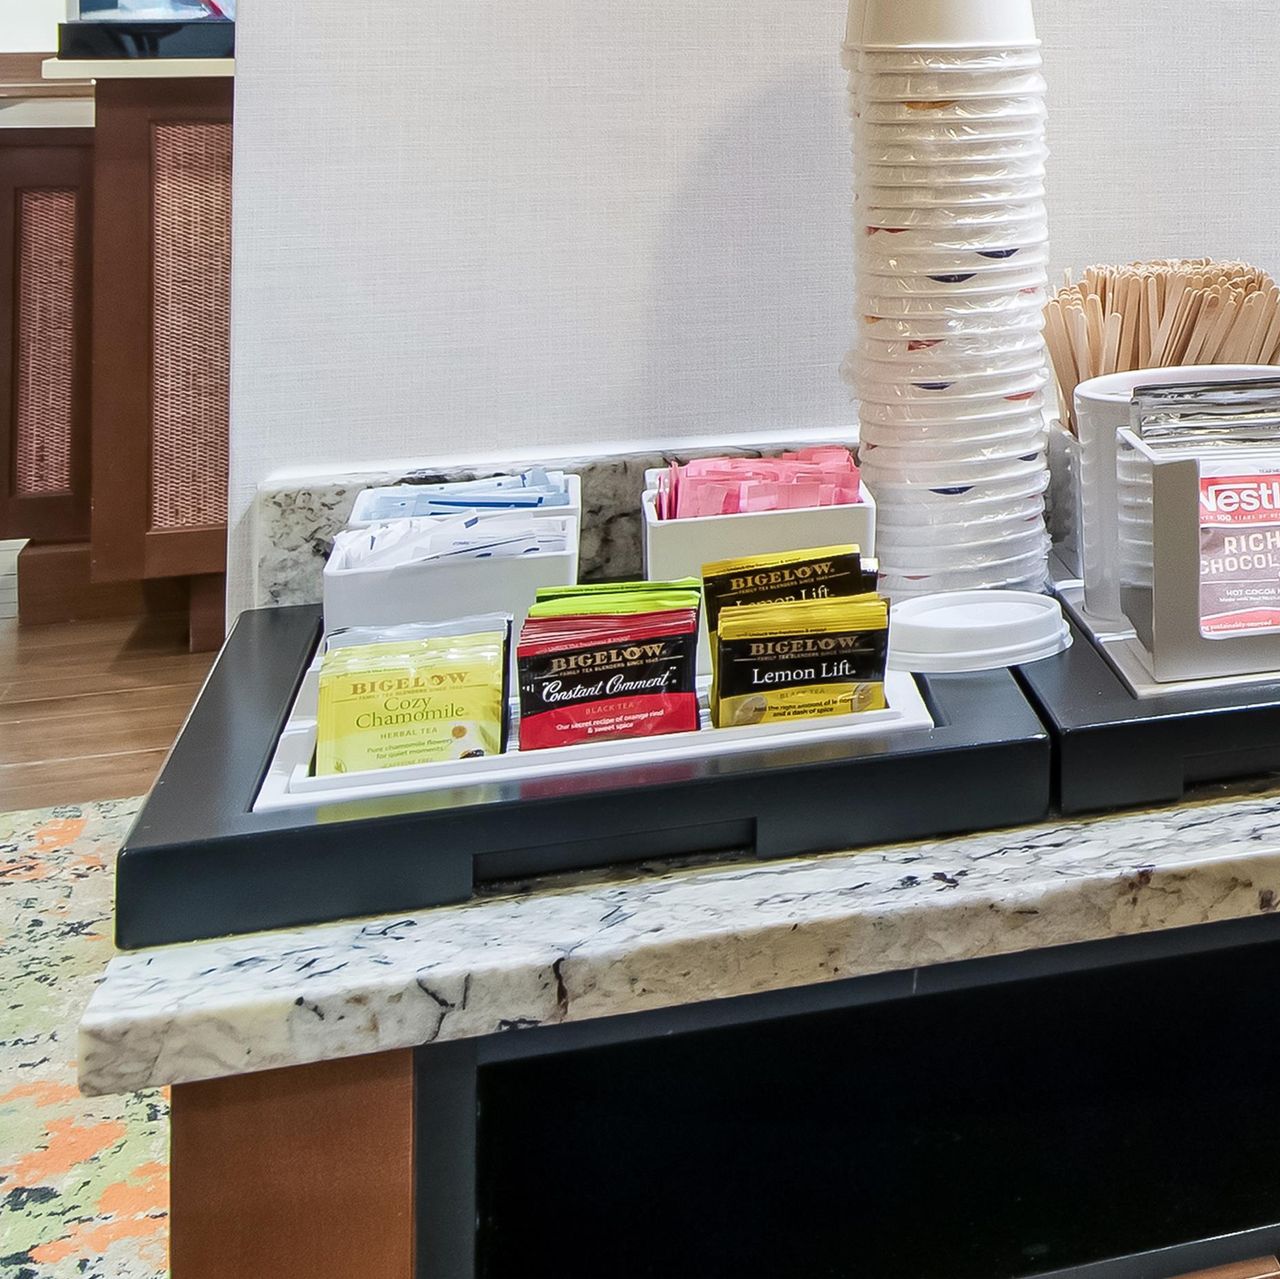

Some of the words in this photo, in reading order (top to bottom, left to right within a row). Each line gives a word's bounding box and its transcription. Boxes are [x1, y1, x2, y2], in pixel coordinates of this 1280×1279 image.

[730, 561, 833, 591] BIGELOW
[551, 642, 665, 671] BIGELOW
[750, 634, 858, 657] BIGELOW
[351, 671, 470, 696] BIGELOW
[752, 668, 815, 685] Lemon
[821, 659, 851, 679] Lift
[356, 702, 466, 730] Chamomile
[383, 696, 432, 713] Cozy
[585, 704, 615, 716] BLACK
[617, 701, 634, 710] TEA
[380, 729, 416, 740] HERBAL
[421, 727, 438, 735] TEA
